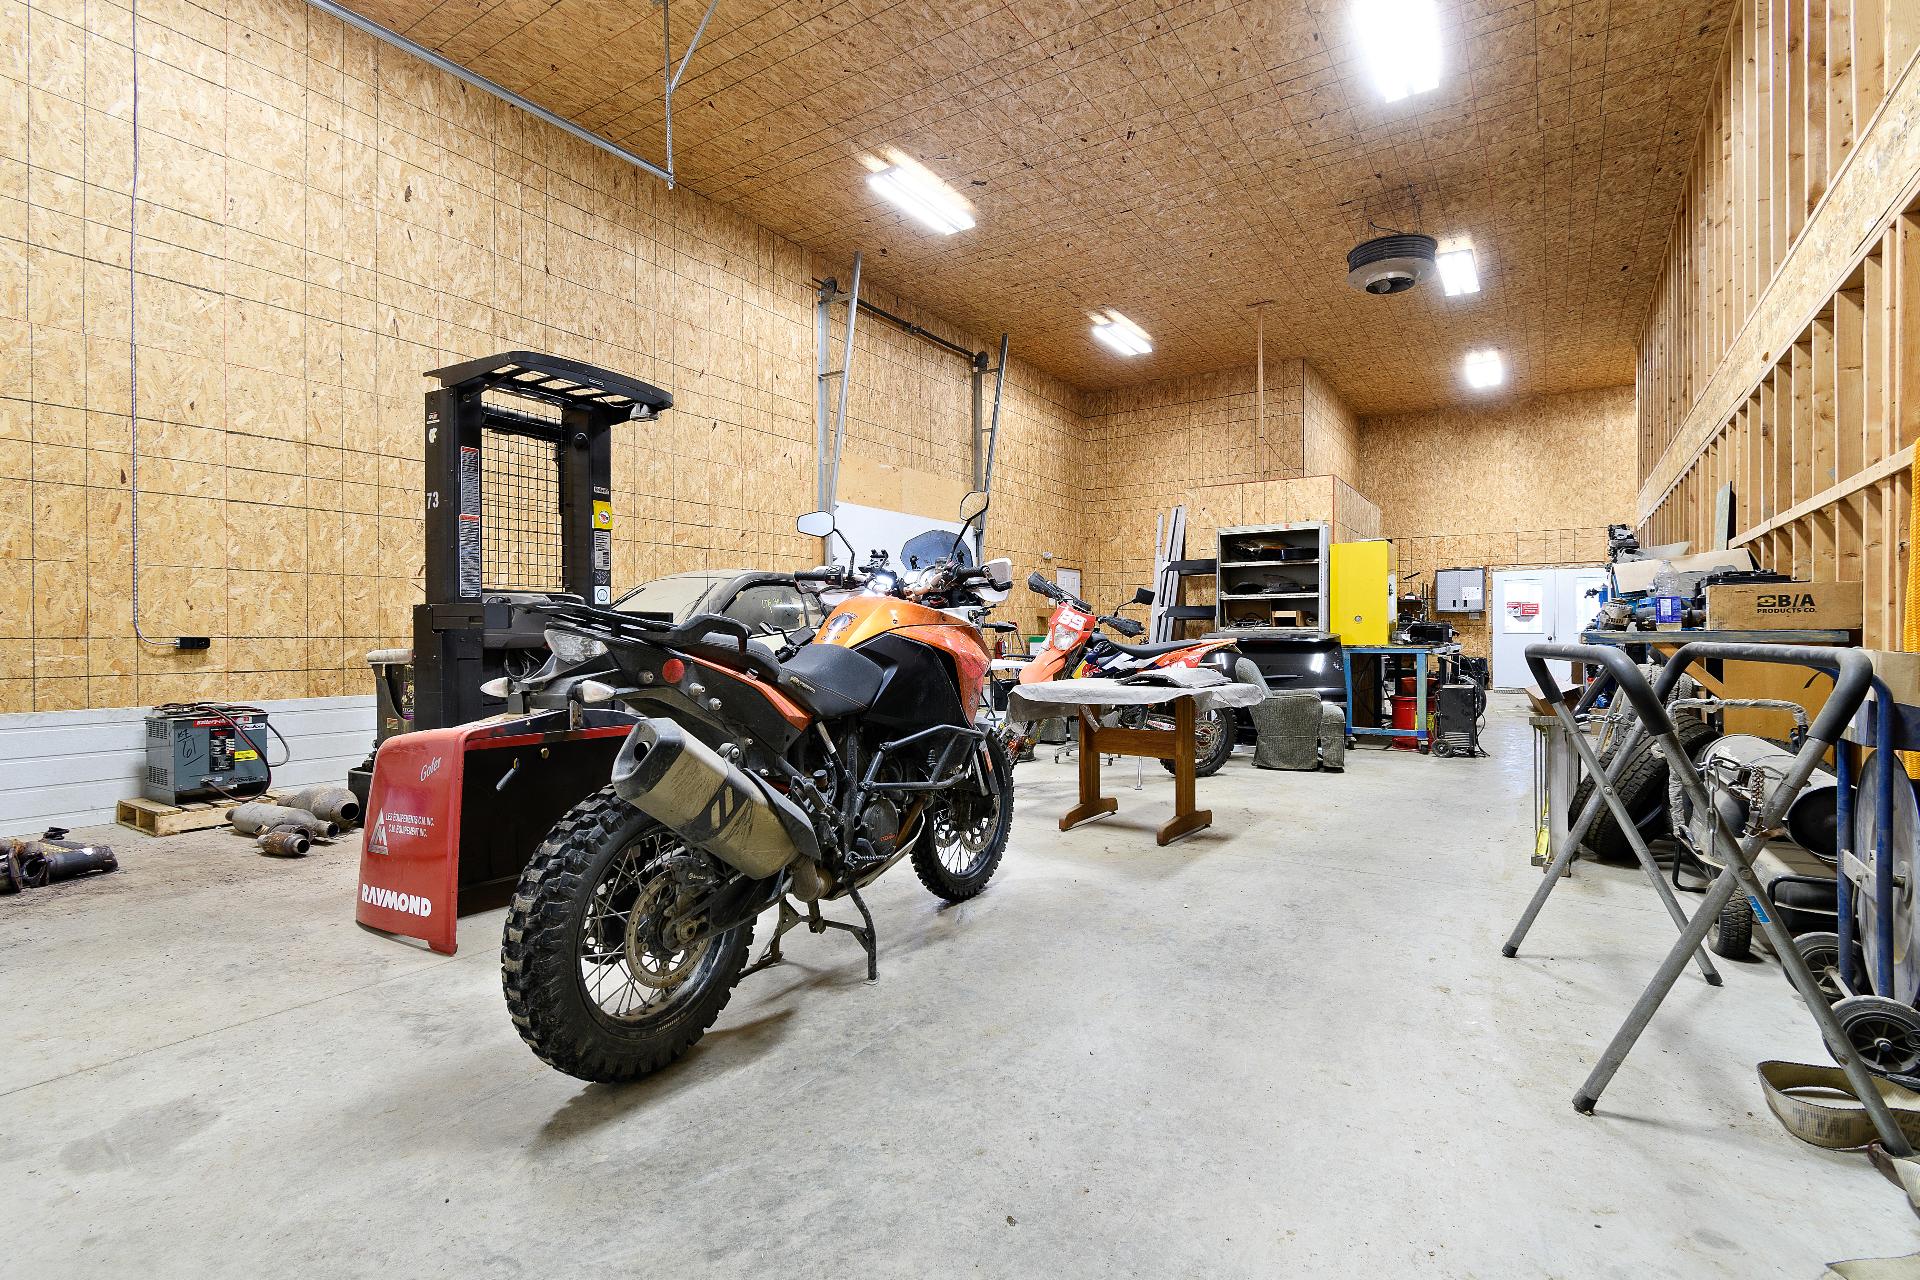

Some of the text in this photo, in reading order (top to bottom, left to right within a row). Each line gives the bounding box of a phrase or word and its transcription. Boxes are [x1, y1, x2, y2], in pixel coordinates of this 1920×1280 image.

[427, 491, 439, 510] 73
[1778, 594, 1816, 607] B/A
[361, 883, 432, 917] RAYMOND
